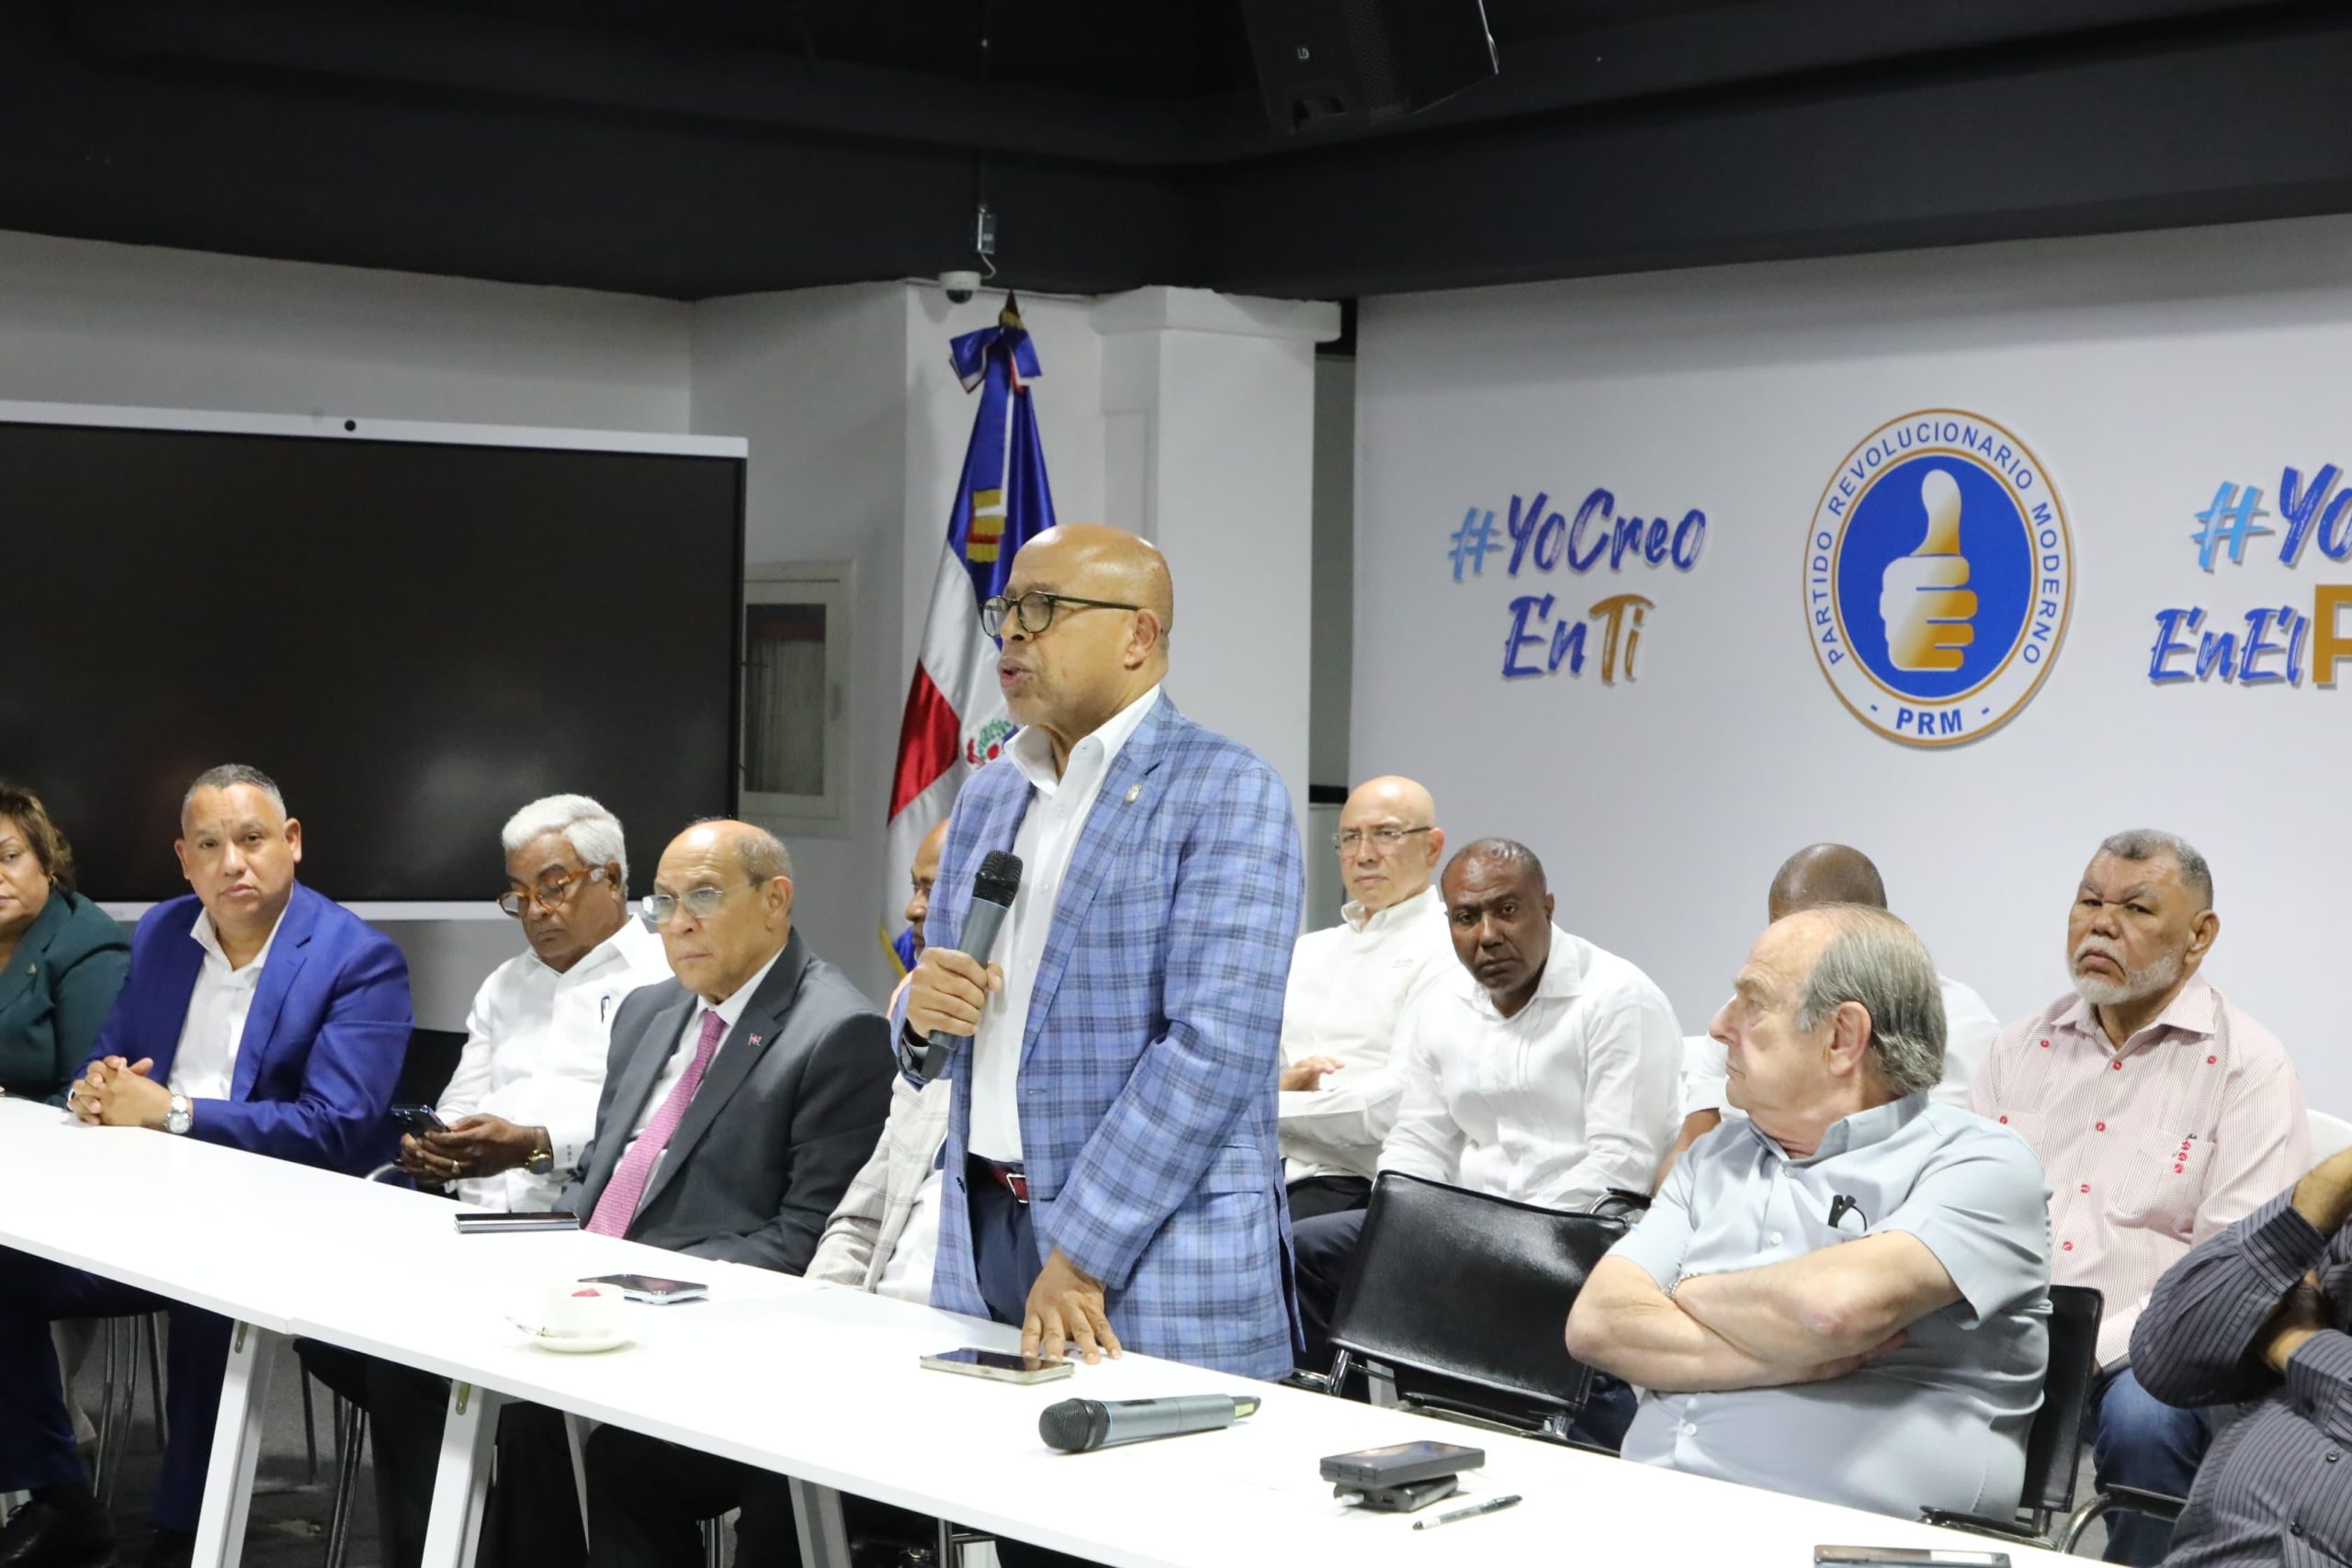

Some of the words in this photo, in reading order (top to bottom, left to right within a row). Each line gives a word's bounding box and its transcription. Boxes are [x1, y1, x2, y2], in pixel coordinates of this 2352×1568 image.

[1828, 422, 2032, 516] REVOLUCIONARIO
[1447, 487, 1706, 581] #YoCreo
[1812, 531, 1845, 665] PARTIDO
[2023, 502, 2060, 664] MODERNO
[1502, 592, 1655, 683] EnTi
[1895, 707, 1963, 735] PRM
